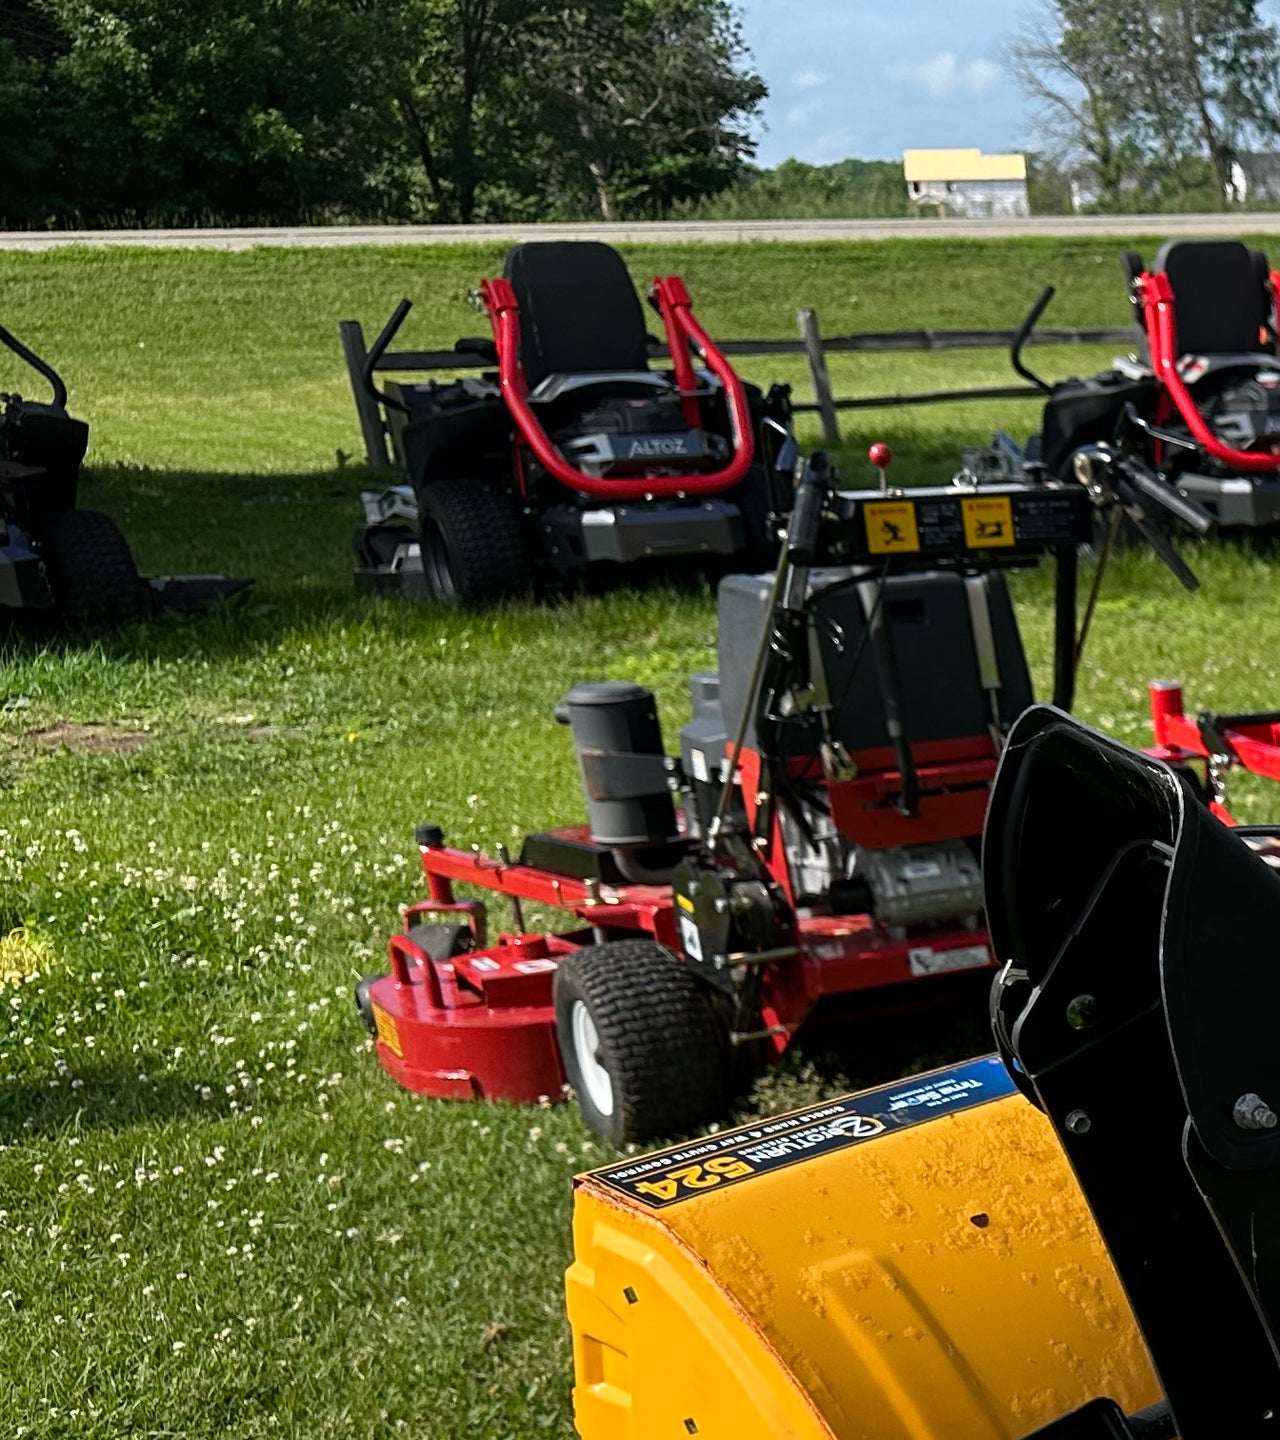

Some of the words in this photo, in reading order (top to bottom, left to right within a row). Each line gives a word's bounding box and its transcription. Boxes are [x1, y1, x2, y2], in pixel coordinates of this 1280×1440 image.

[629, 438, 687, 459] ALTOZ
[799, 1106, 844, 1122] SINGLE
[762, 1119, 799, 1132] HAND
[719, 1134, 749, 1148] WAY
[672, 1143, 719, 1162] CHUTE
[608, 1157, 673, 1181] CONTROL
[634, 1156, 756, 1201] 524
